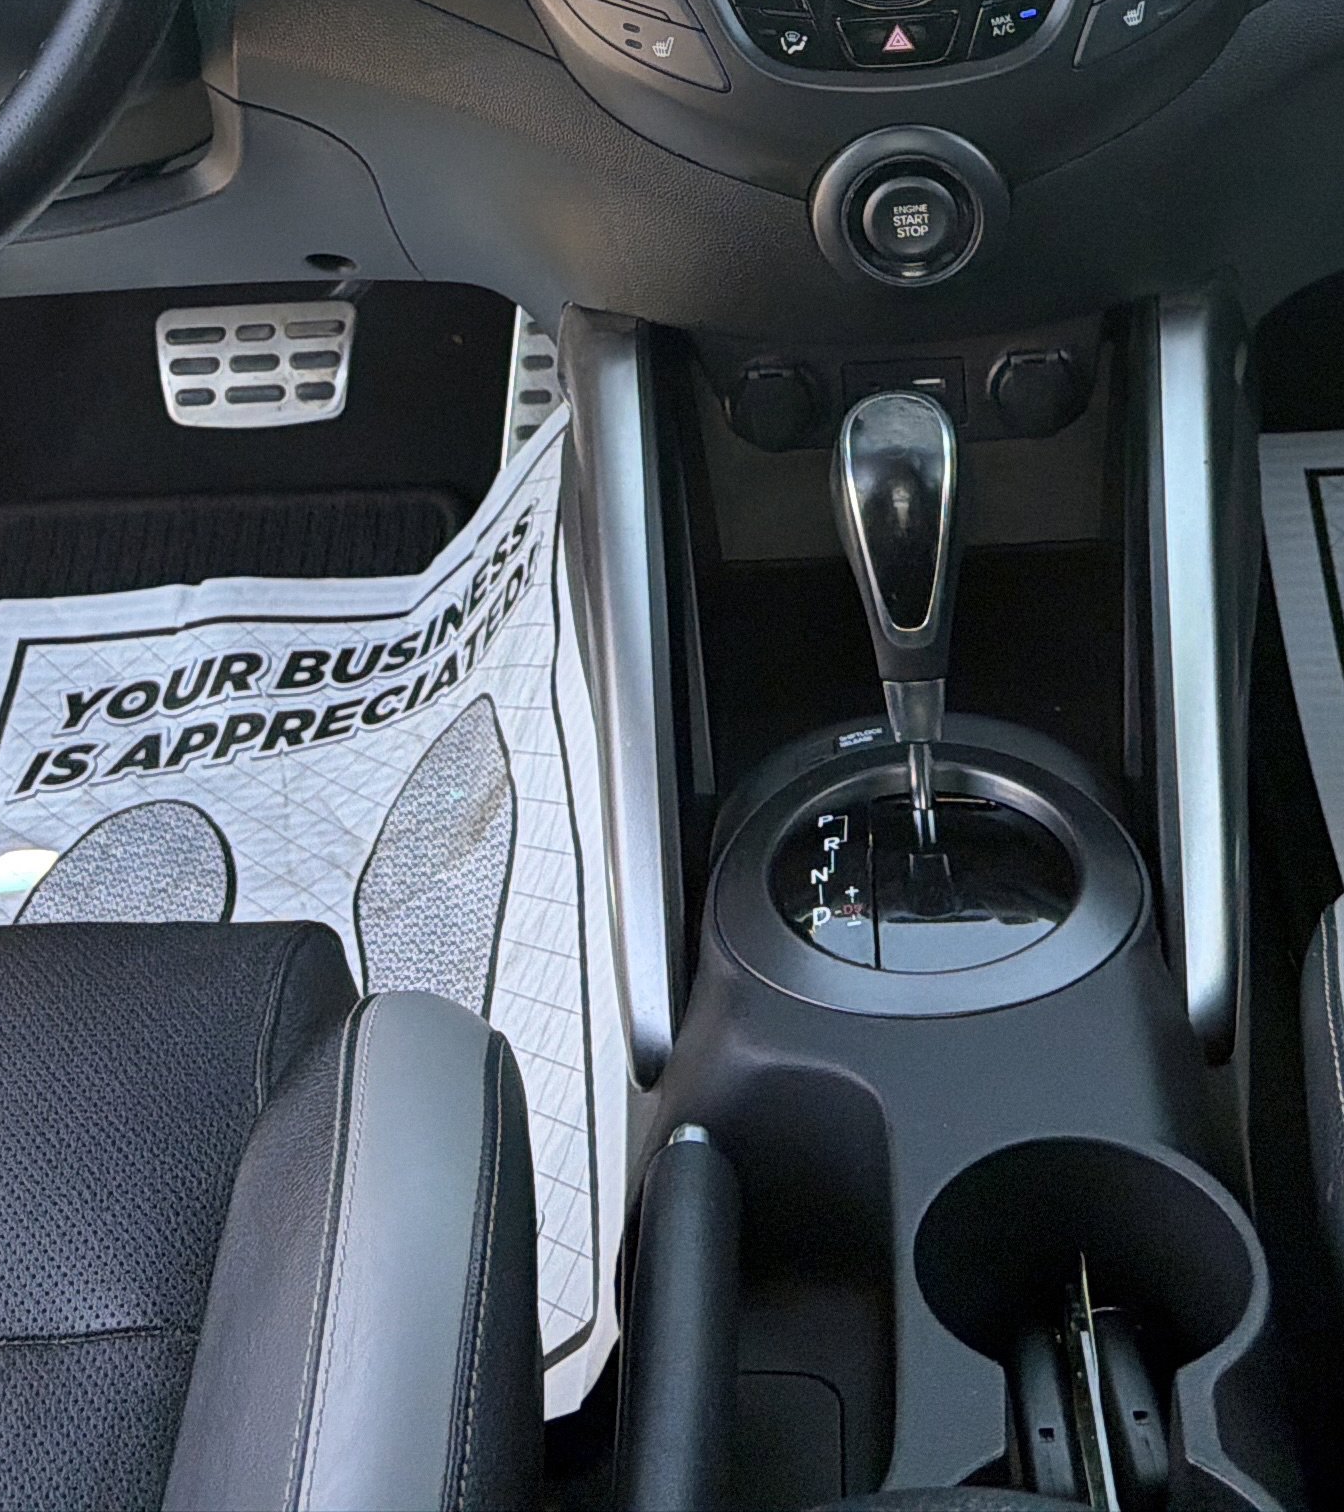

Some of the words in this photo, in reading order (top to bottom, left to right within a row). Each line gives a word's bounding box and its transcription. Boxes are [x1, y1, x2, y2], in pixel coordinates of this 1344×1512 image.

[991, 14, 1012, 28] MAX
[992, 23, 1016, 37] A/C
[893, 203, 928, 215] ENGINE
[892, 214, 929, 227] START
[896, 225, 929, 238] STOP
[62, 652, 264, 731] YOUR
[272, 501, 538, 690] BUSINESS
[14, 743, 96, 795] IS
[104, 536, 542, 776] APPRECIATED!
[817, 814, 834, 828] P
[824, 837, 840, 852] R
[811, 866, 828, 884] N
[812, 906, 831, 926] D
